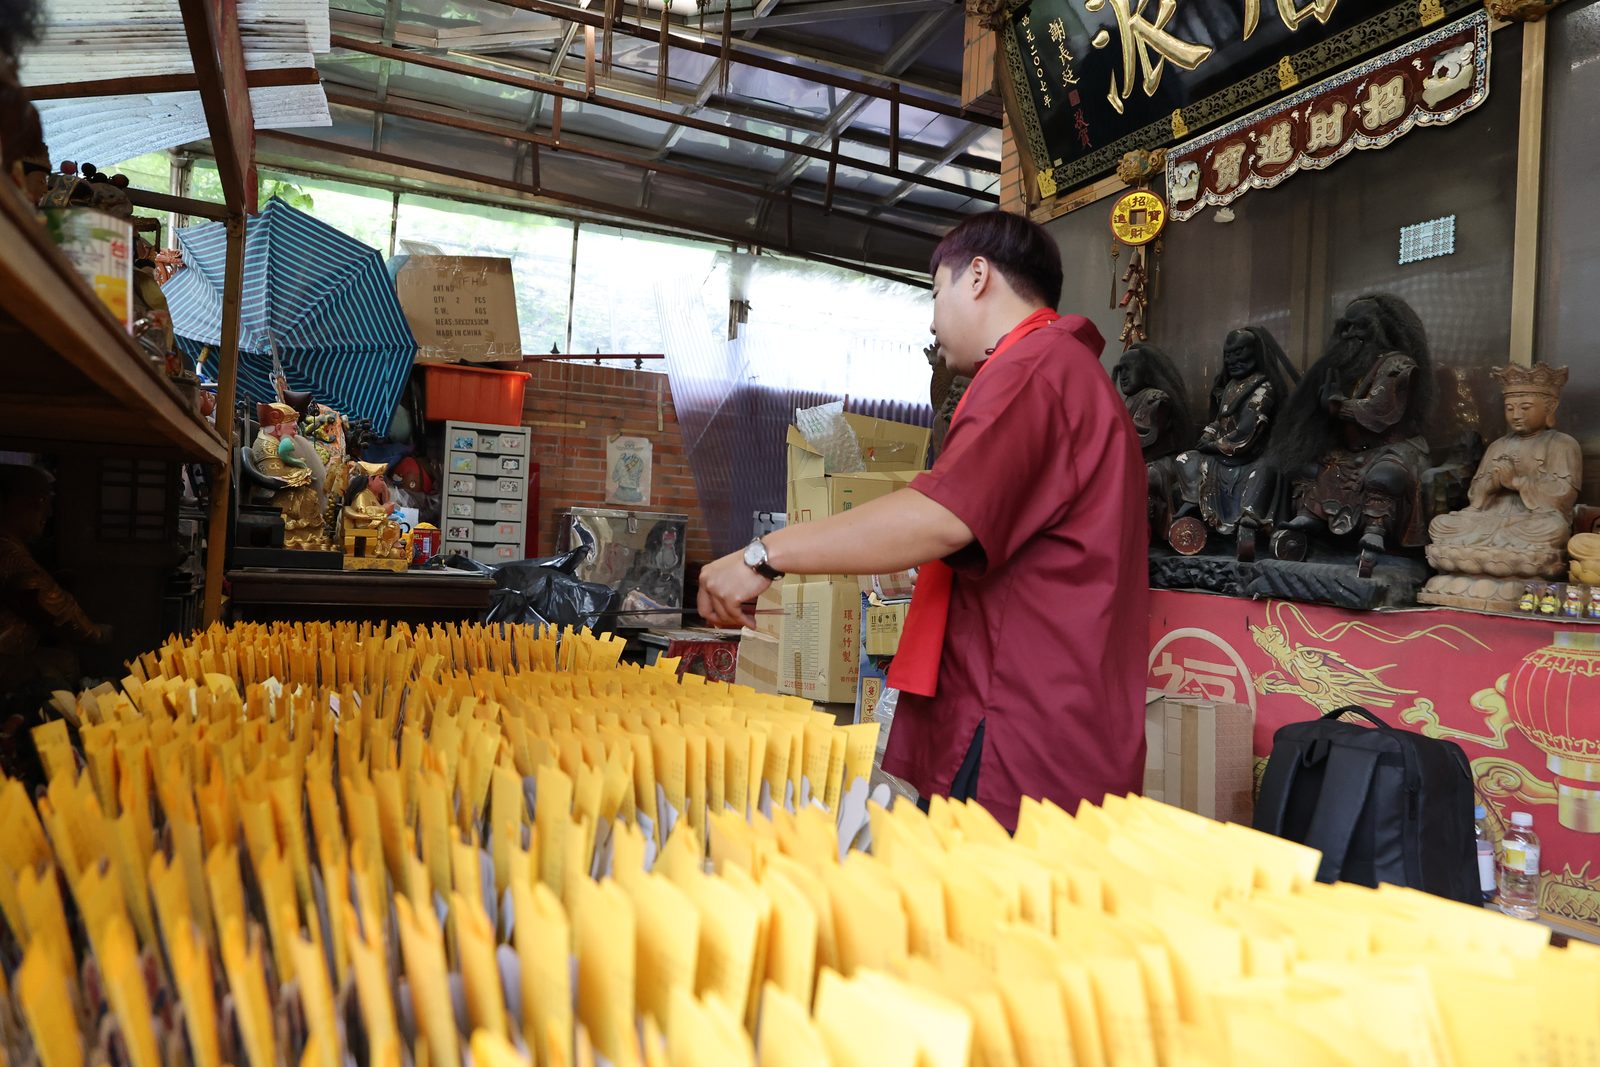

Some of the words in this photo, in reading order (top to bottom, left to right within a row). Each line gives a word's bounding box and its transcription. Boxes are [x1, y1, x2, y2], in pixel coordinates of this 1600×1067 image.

[436, 329, 453, 337] MADE
[454, 329, 462, 337] IN
[462, 329, 482, 337] CHINA
